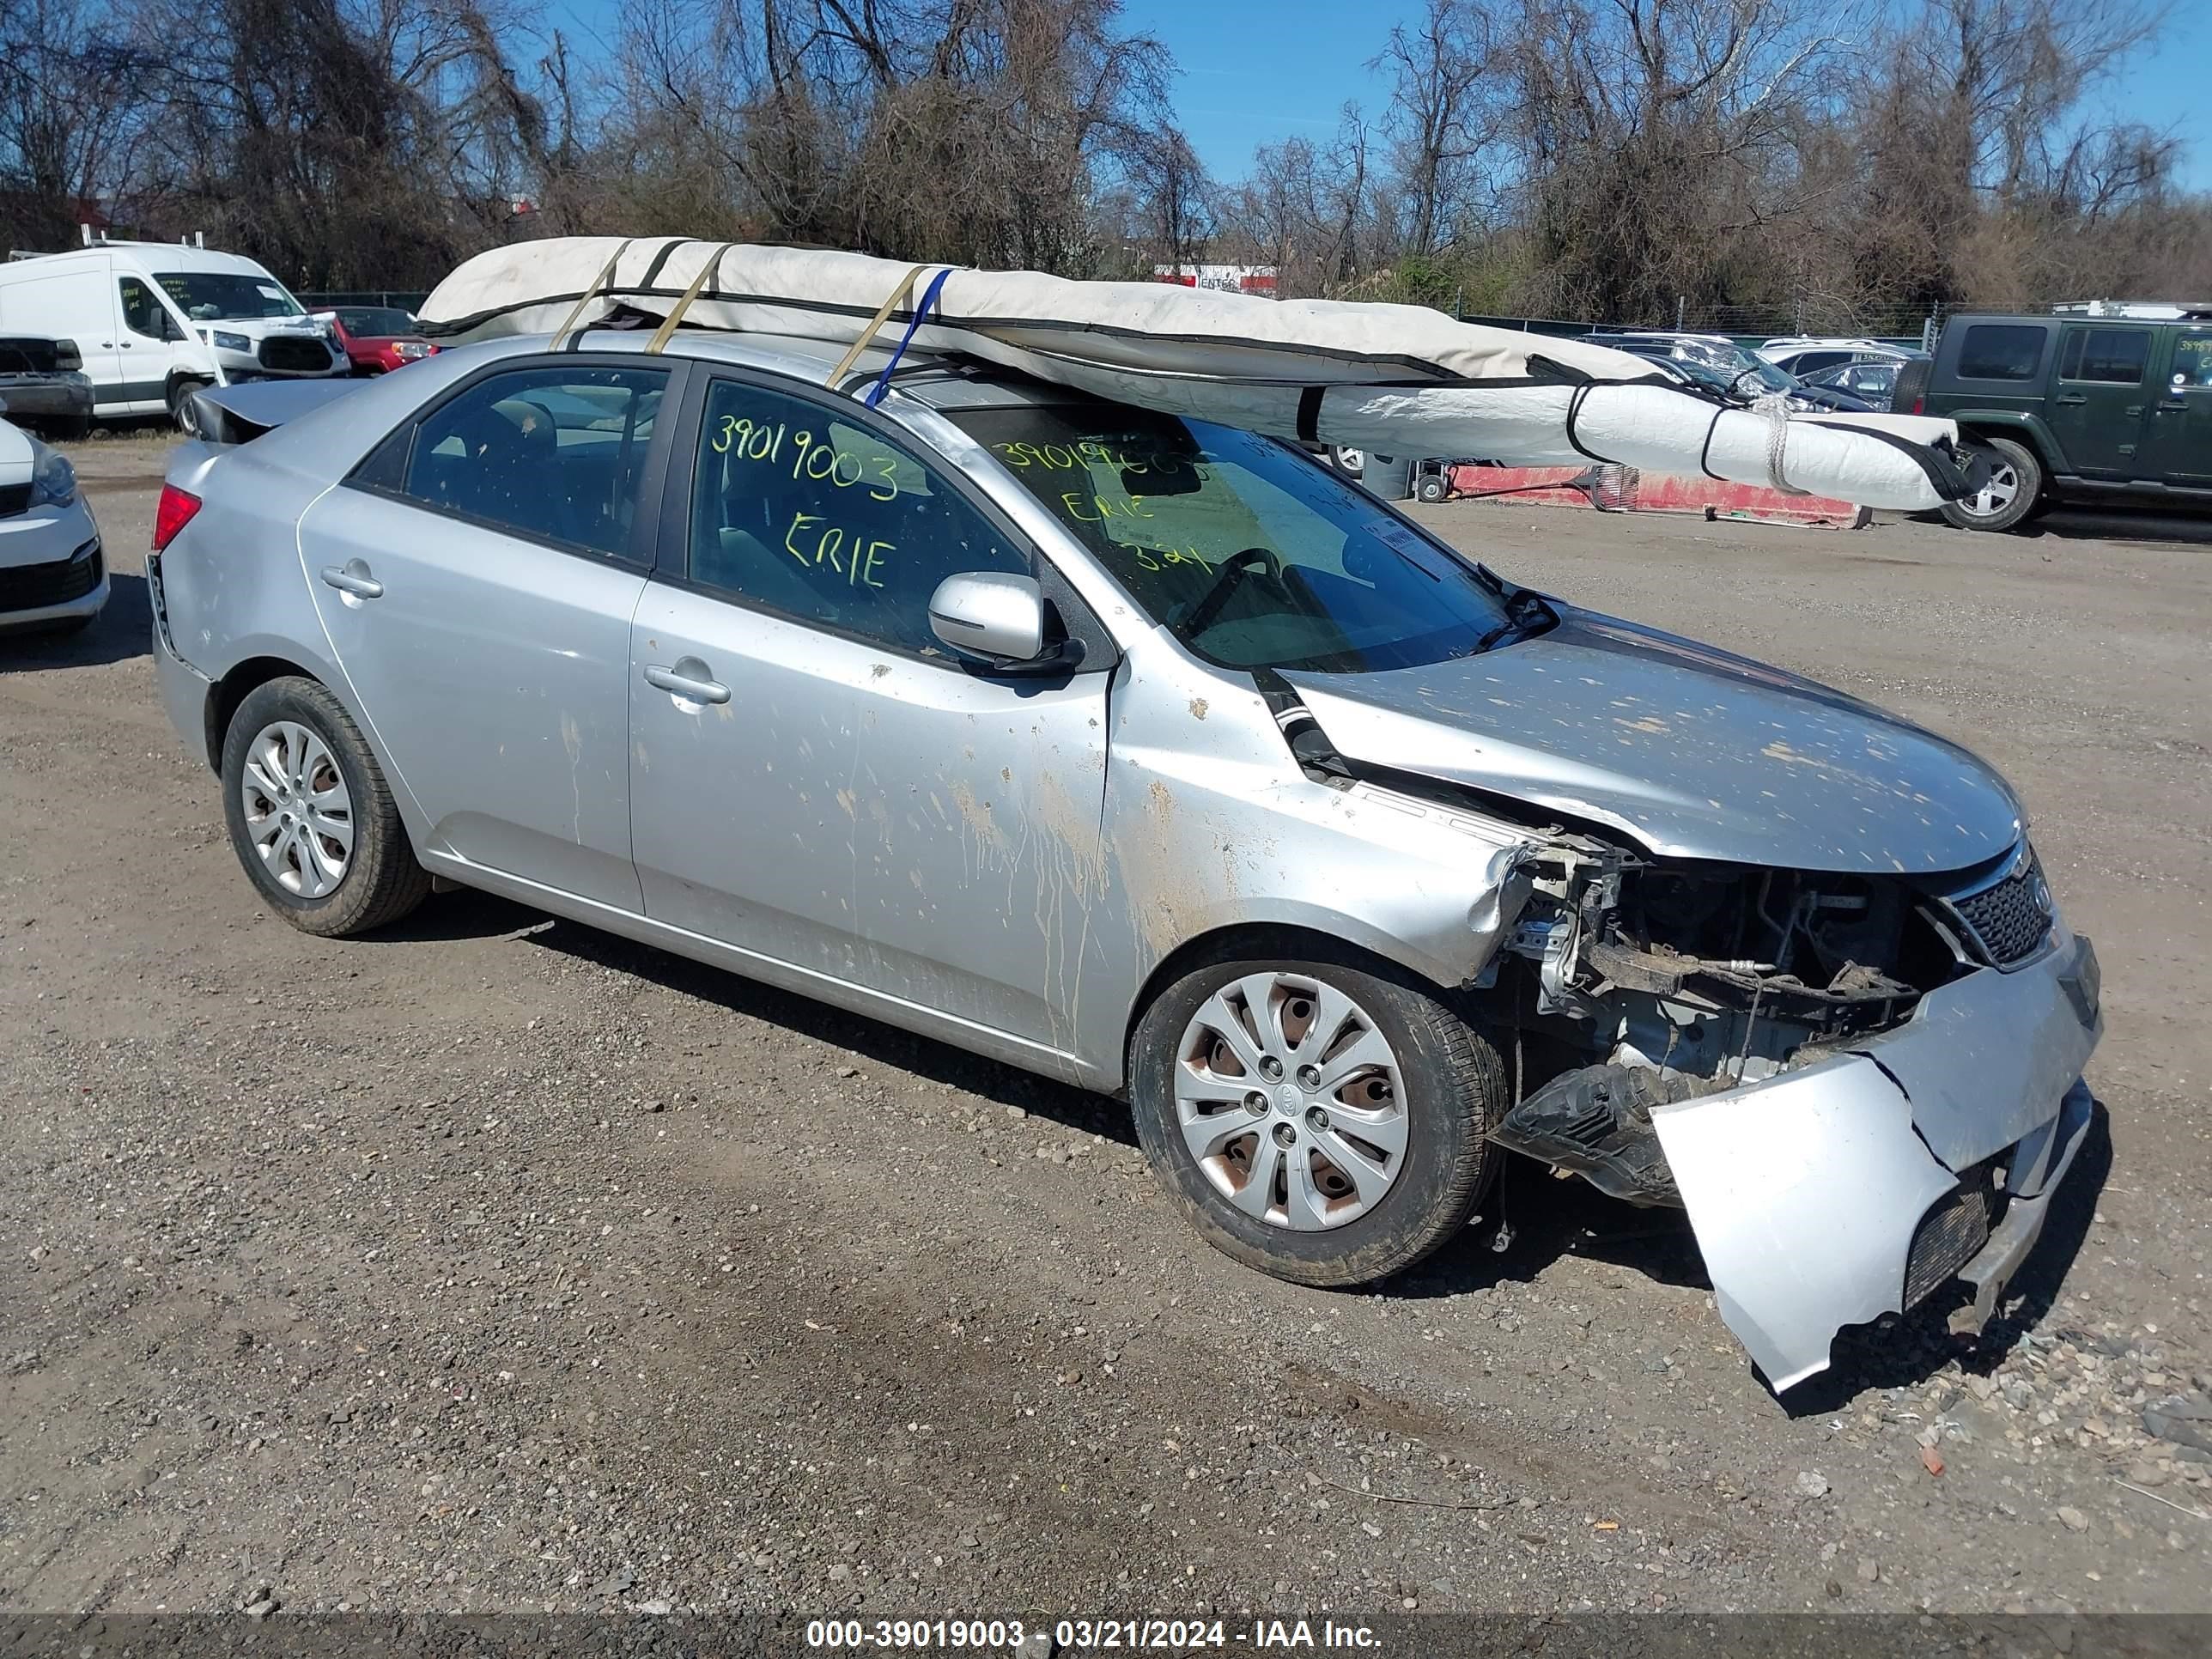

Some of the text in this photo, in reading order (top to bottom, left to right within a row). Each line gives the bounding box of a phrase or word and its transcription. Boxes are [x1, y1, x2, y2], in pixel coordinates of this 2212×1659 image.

[712, 416, 897, 501] 39019003
[1061, 492, 1154, 520] ERIE
[786, 512, 896, 586] ERIE
